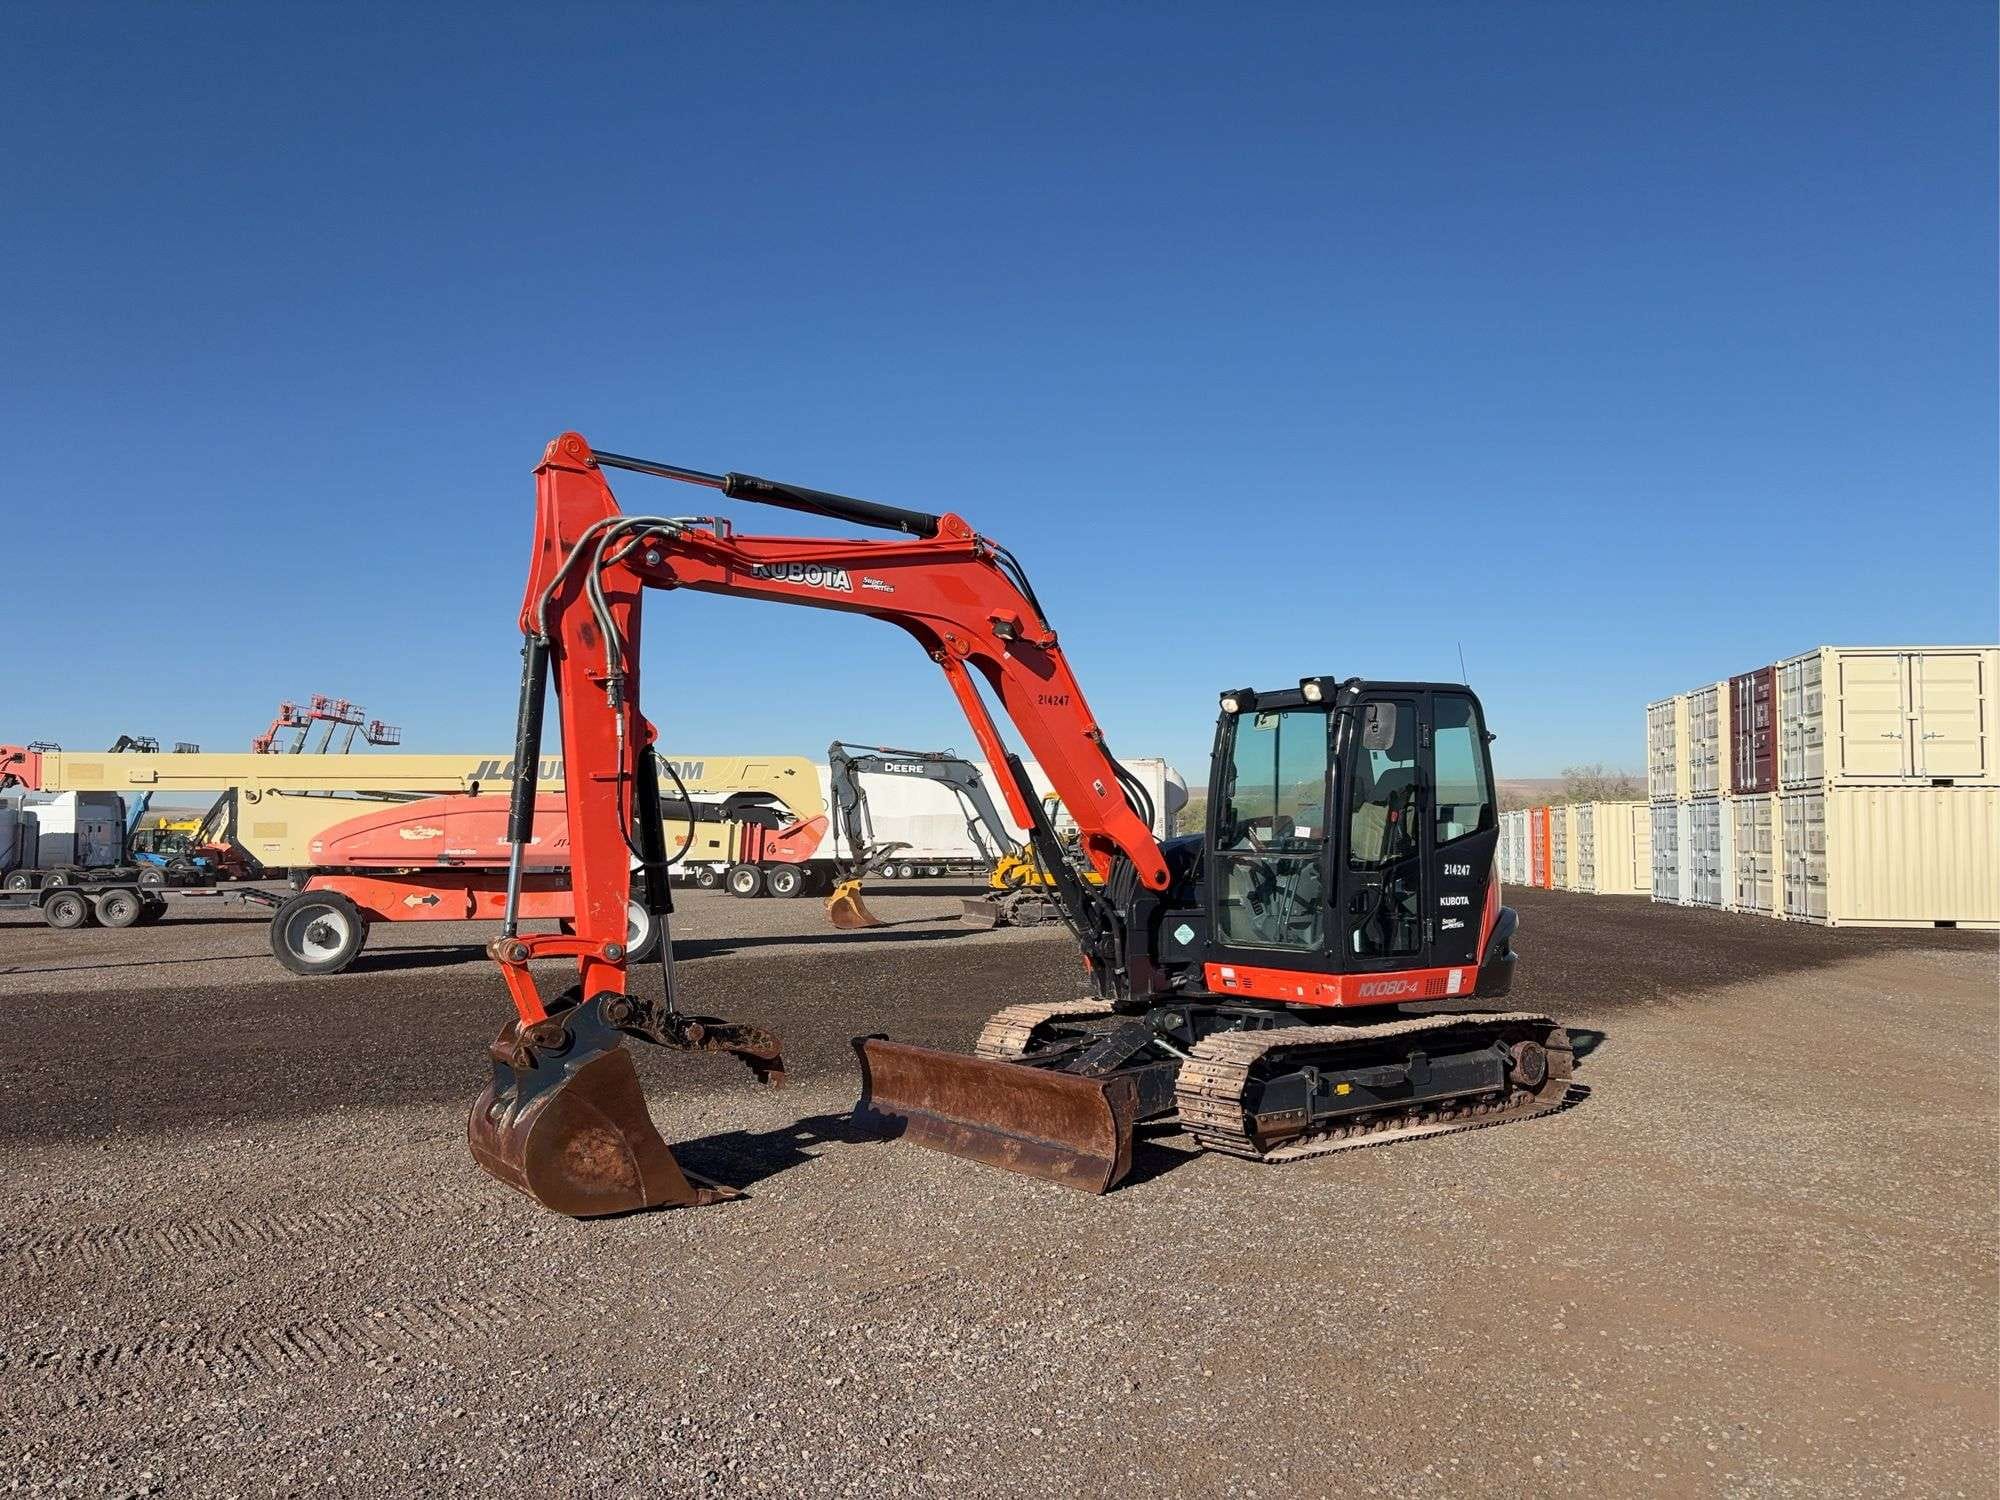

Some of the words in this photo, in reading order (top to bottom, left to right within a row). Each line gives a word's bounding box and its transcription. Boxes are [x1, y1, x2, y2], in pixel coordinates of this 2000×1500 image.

[752, 562, 852, 591] KUBOTA
[862, 576, 884, 586] Super
[1038, 694, 1069, 706] 214247
[884, 762, 924, 773] DEERE
[1444, 863, 1470, 876] 214247
[1440, 896, 1469, 906] KUBOTA
[1359, 980, 1418, 997] KX080-4
